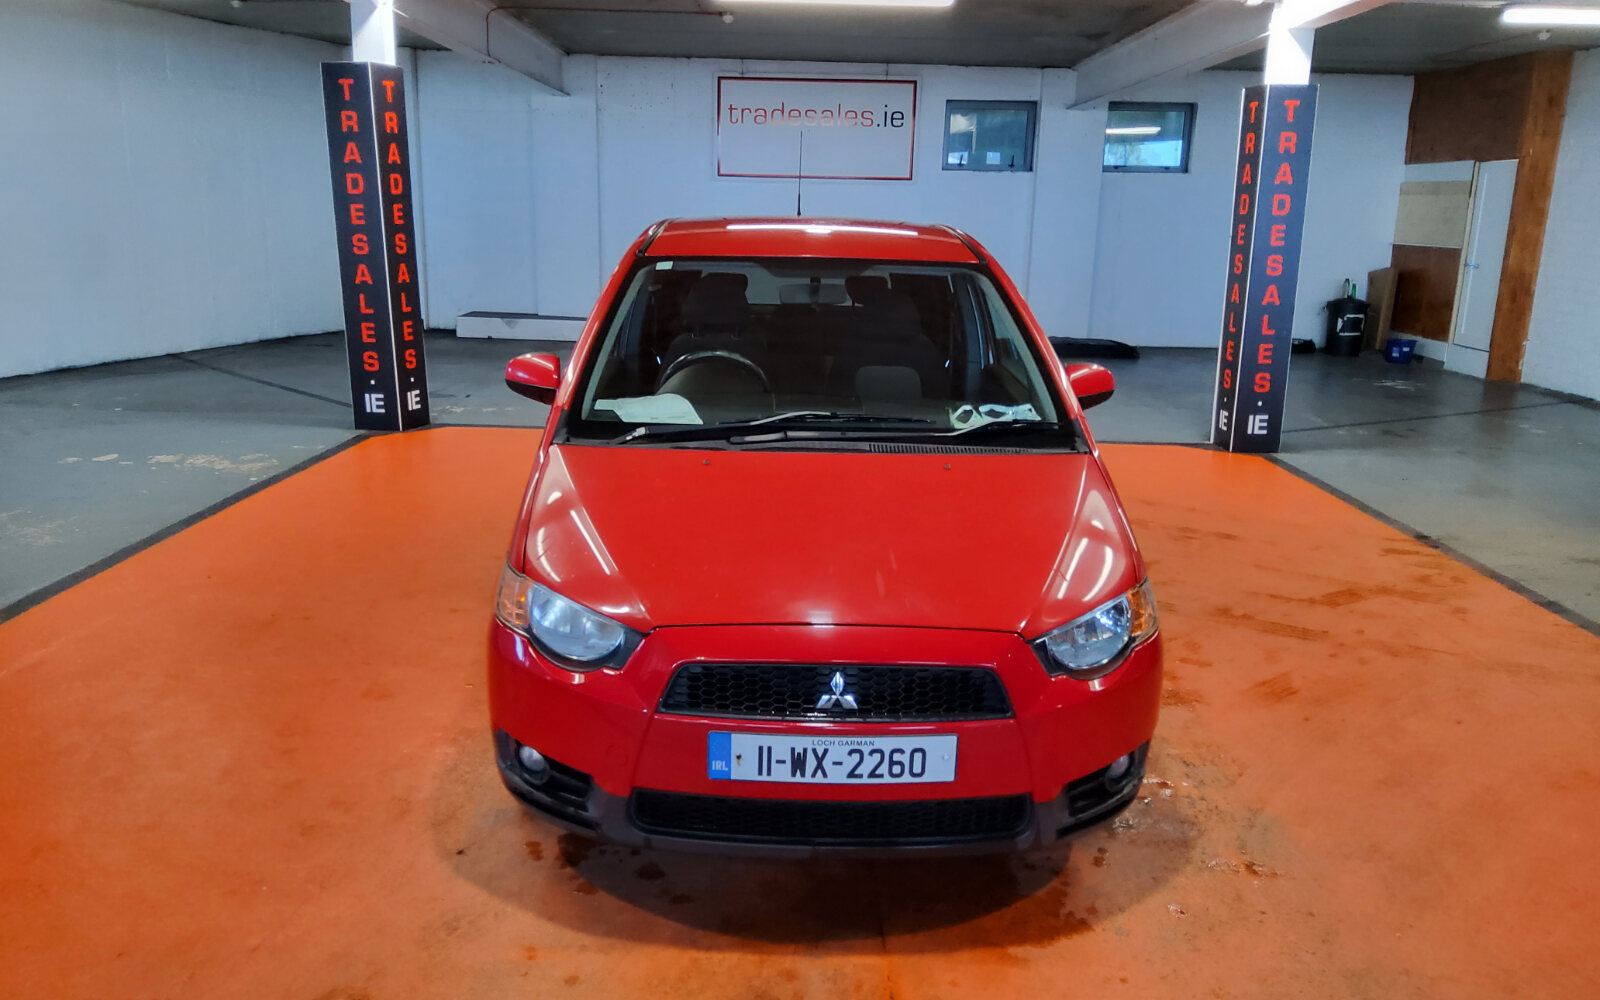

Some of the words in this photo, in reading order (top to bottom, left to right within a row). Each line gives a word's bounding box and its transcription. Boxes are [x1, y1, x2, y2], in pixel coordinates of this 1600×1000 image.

[728, 101, 905, 128] tradesales.ie
[812, 739, 836, 747] LOCH
[838, 739, 875, 747] GARMAN
[711, 760, 728, 771] IRL
